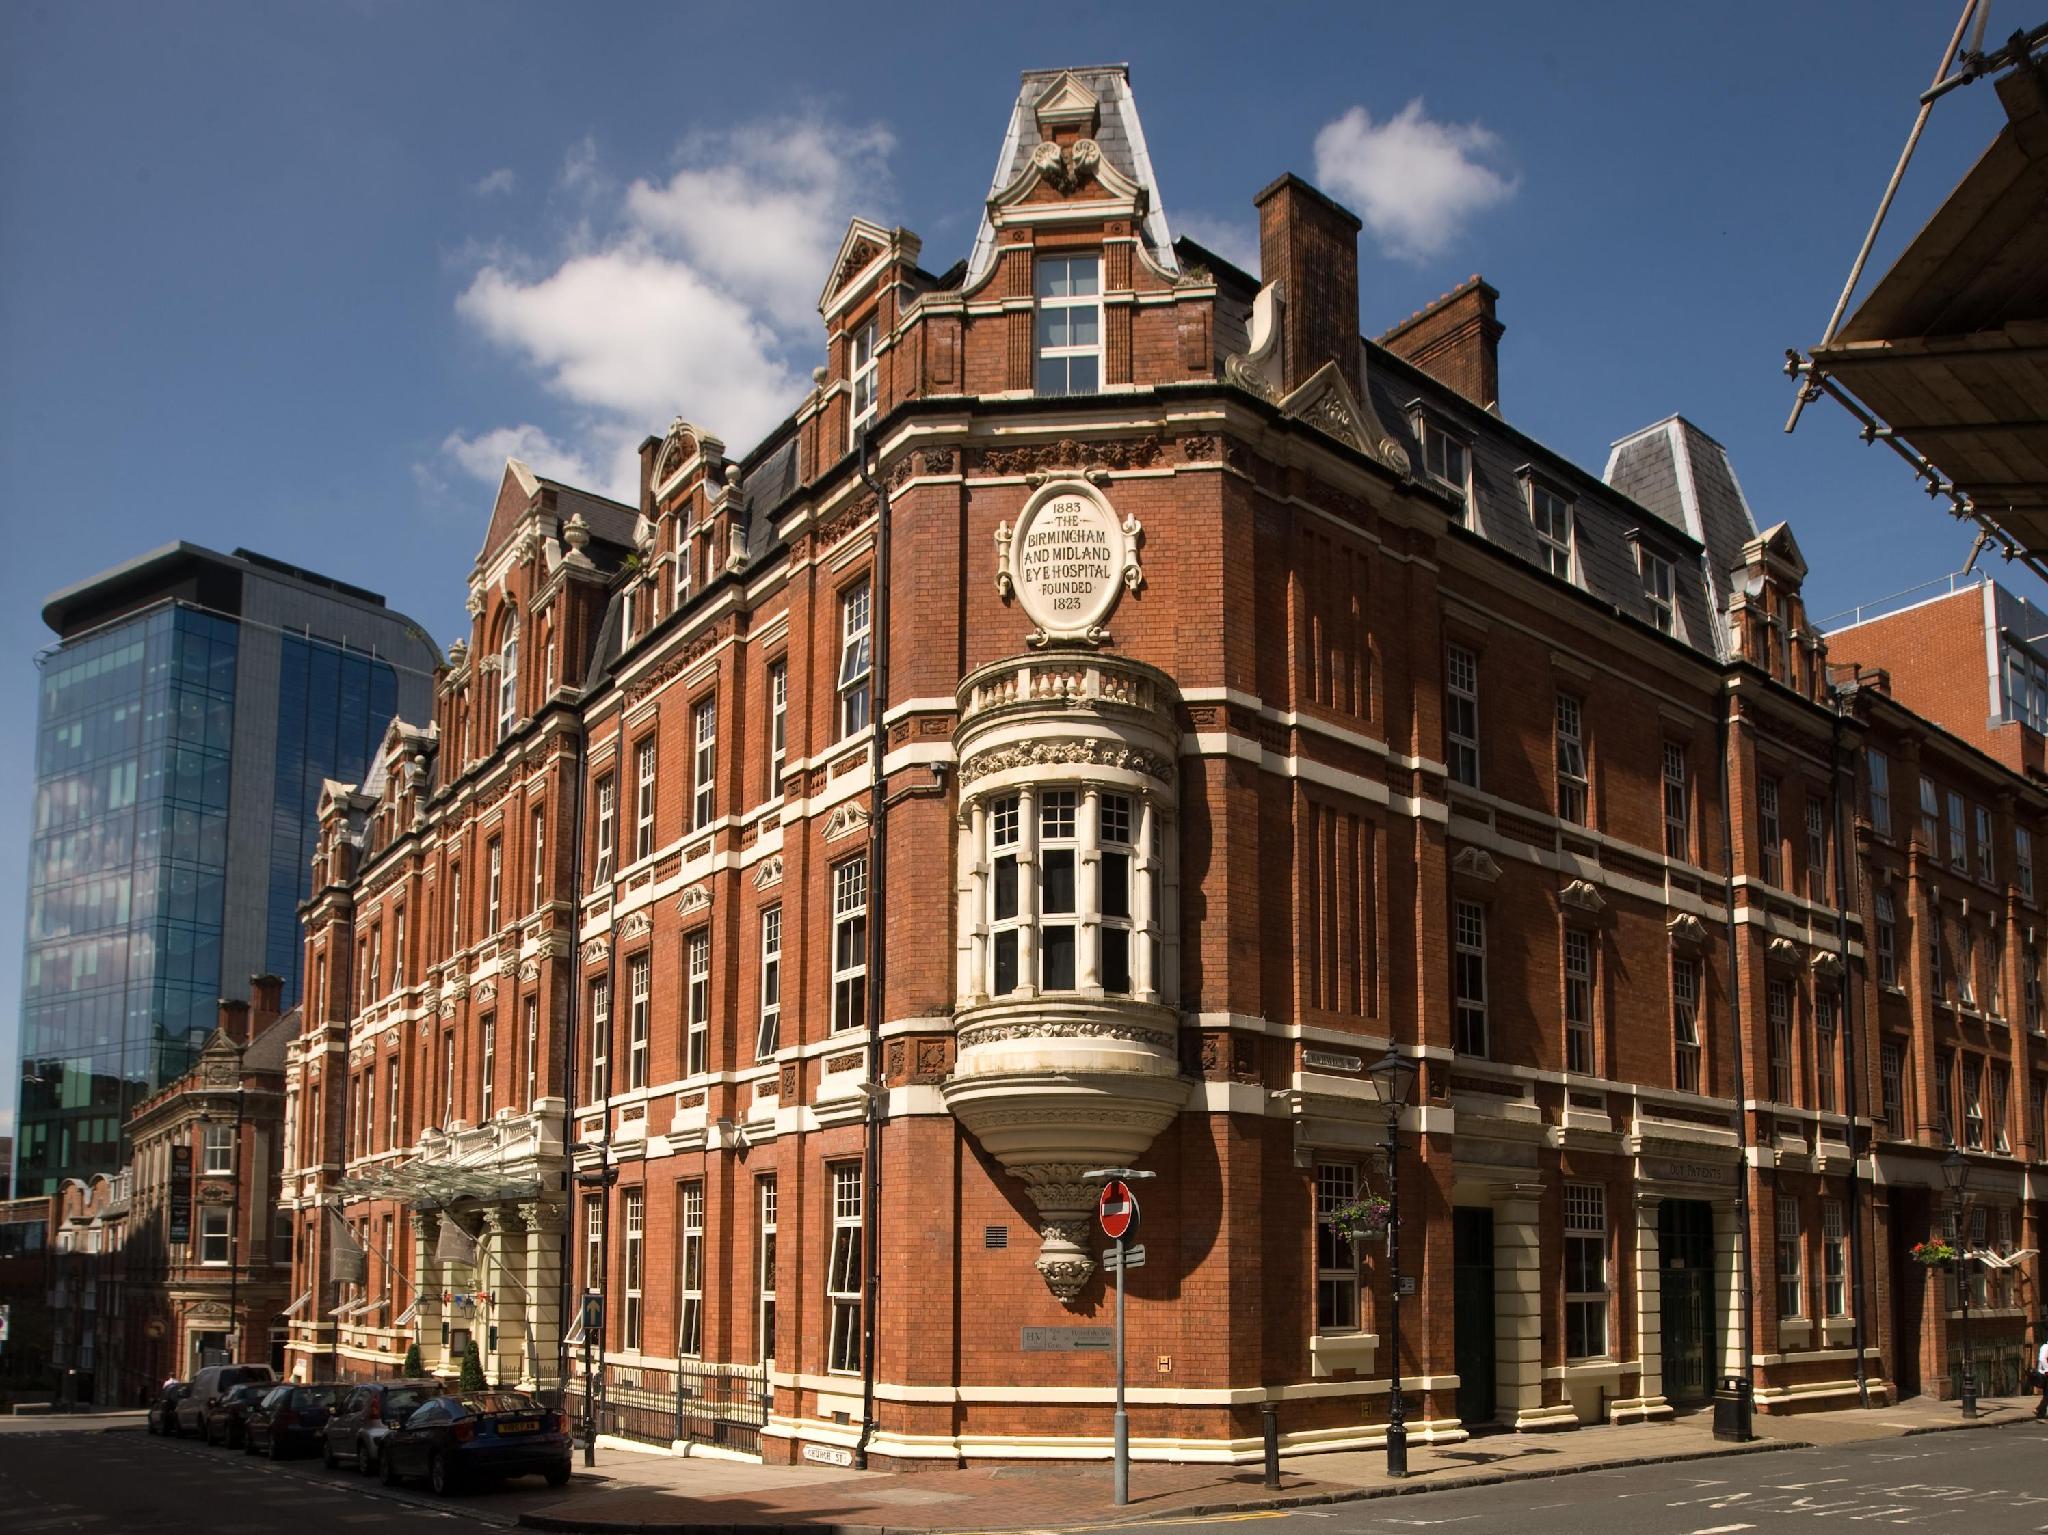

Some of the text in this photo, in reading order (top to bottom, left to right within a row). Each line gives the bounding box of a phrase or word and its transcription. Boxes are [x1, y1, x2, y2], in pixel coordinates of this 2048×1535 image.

[1053, 502, 1081, 513] 1883
[1055, 516, 1079, 527] THE
[1028, 531, 1105, 547] BIRMINGHAM
[1024, 547, 1111, 565] AND MIDLAND
[1026, 564, 1111, 582] EYE HOSPITAL
[1042, 582, 1092, 596] FOUNDED
[1053, 598, 1081, 610] 1823
